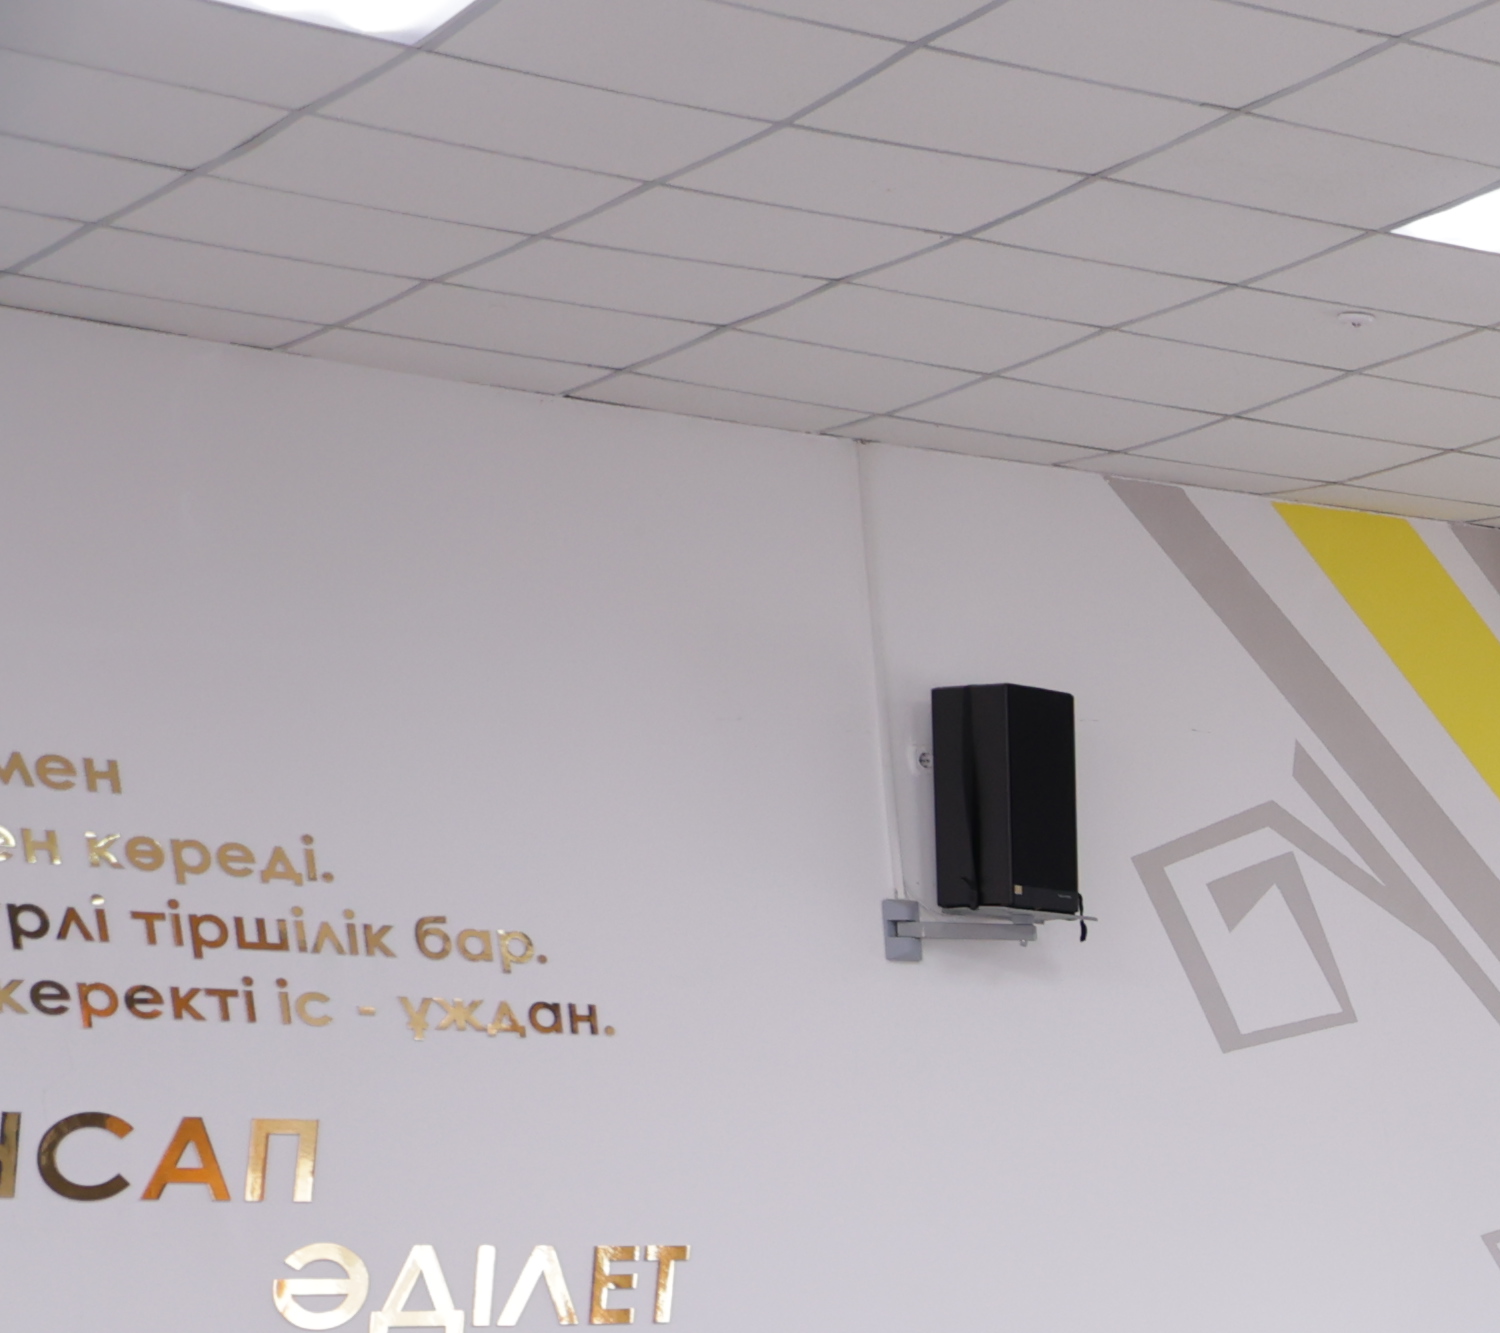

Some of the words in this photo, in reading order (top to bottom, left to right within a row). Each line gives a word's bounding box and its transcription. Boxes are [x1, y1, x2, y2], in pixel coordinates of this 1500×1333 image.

[84, 830, 335, 887] көреді.
[6, 893, 111, 950] рлі
[129, 898, 398, 960] тіршілік
[414, 914, 548, 974] бар.
[0, 975, 258, 1029] керекті
[275, 977, 334, 1027] іс
[397, 995, 616, 1041] ұждан.
